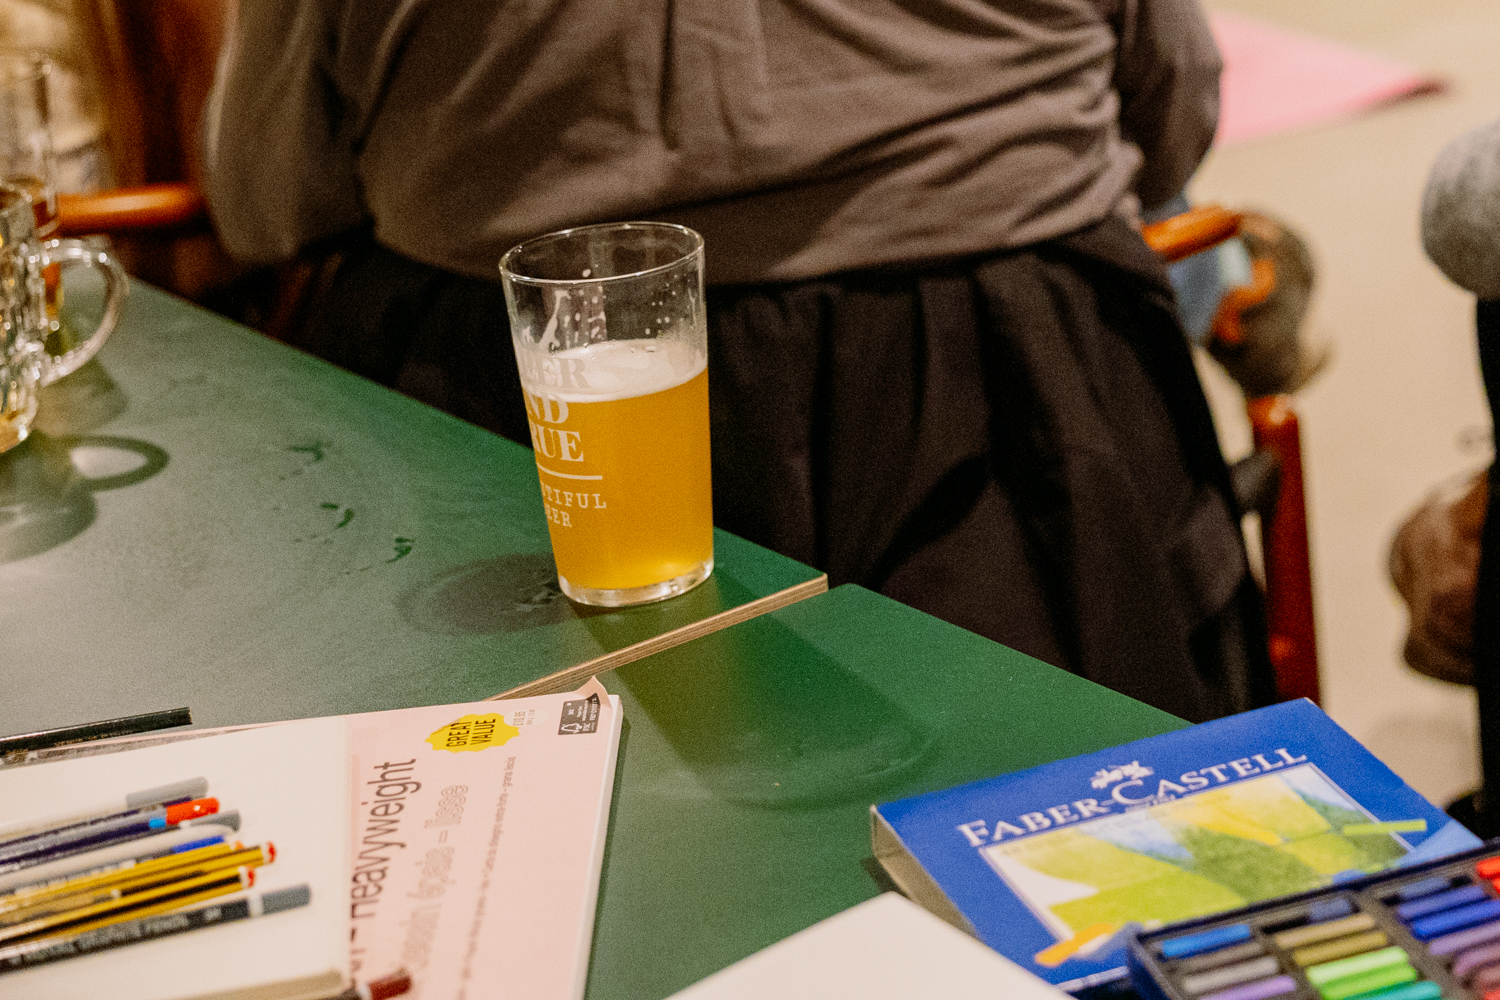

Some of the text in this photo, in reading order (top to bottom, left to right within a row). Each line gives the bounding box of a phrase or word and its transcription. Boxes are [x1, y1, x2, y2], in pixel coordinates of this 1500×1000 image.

[527, 391, 569, 424] ND
[530, 420, 584, 462] RUE
[542, 482, 607, 509] TIFUL
[446, 721, 473, 748] GREAT
[470, 718, 497, 746] VALUE
[957, 748, 1307, 847] FABER-CASTELL
